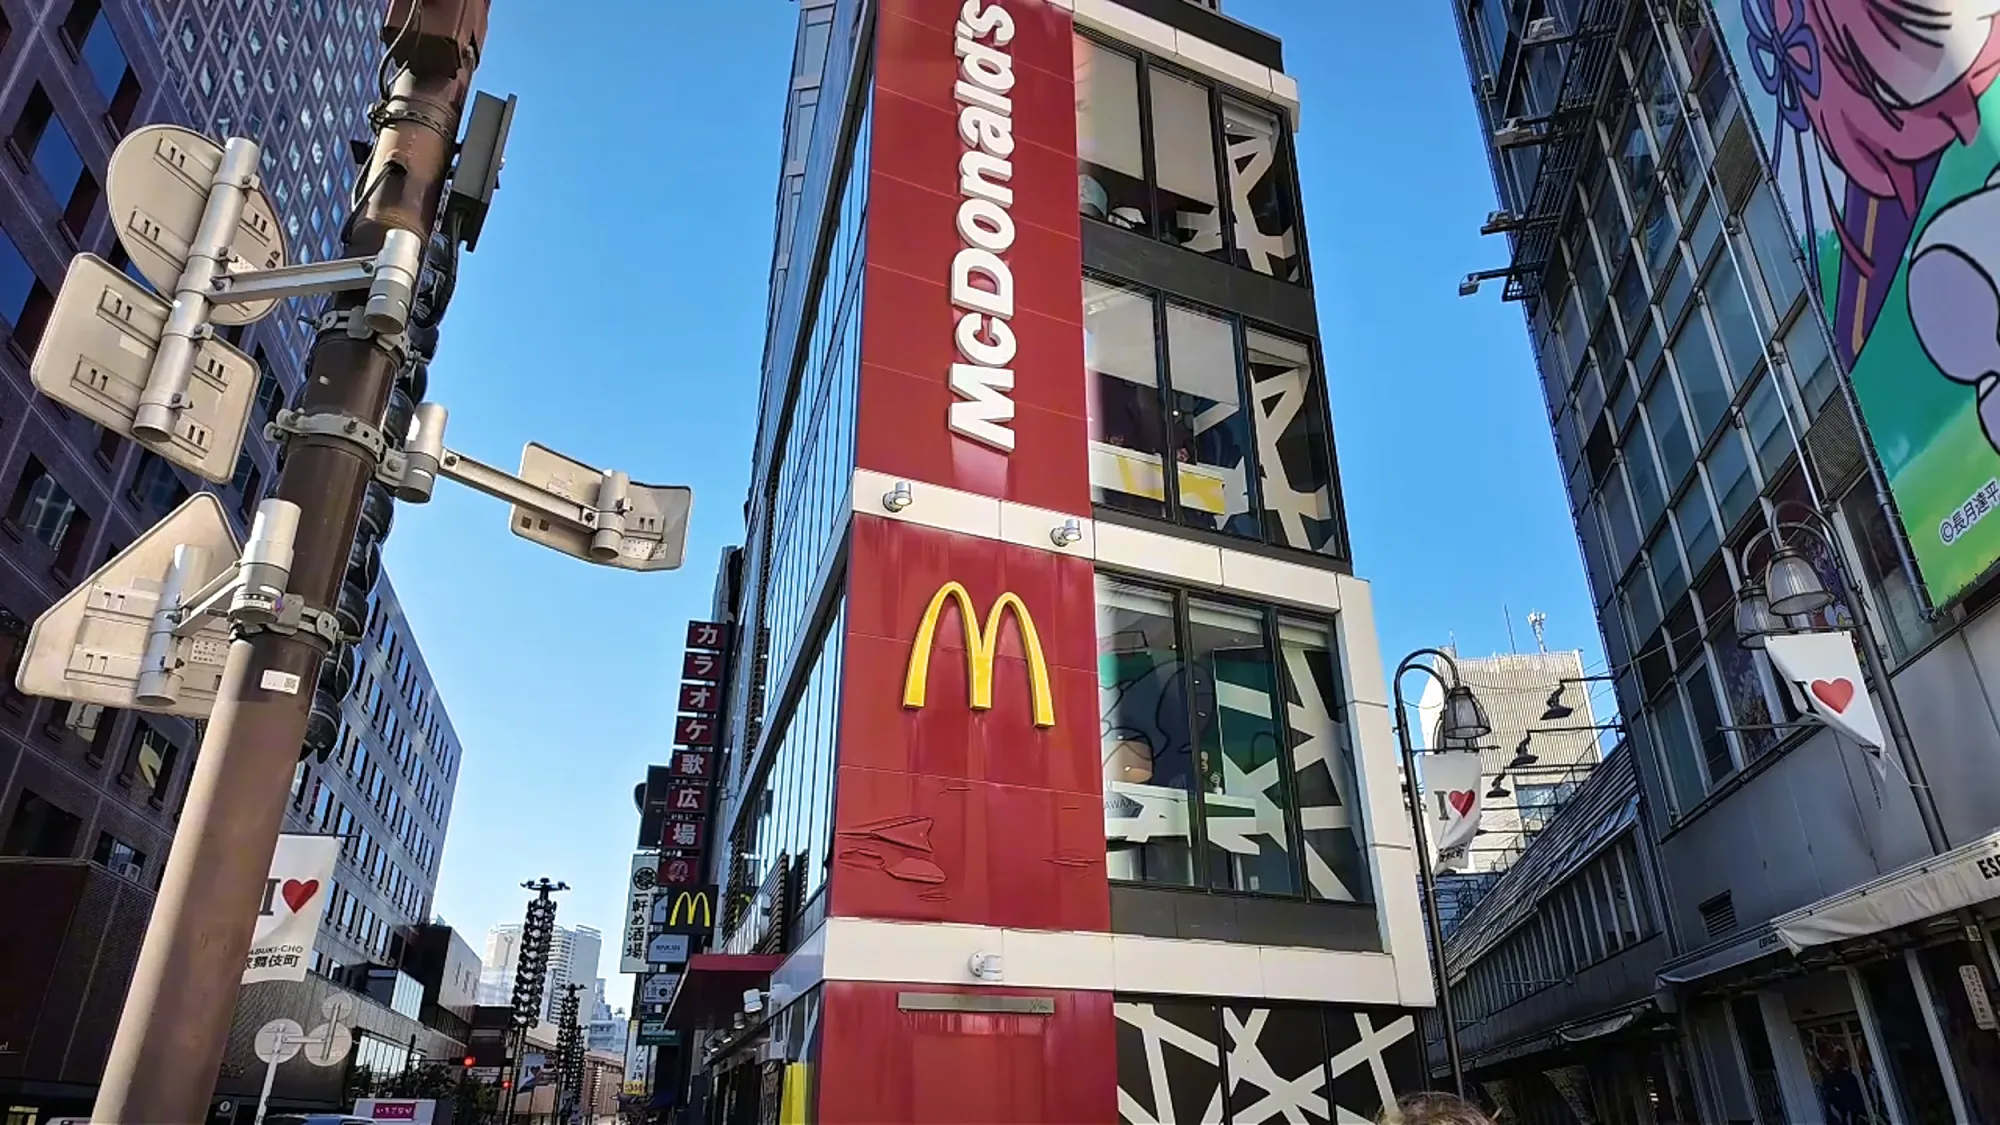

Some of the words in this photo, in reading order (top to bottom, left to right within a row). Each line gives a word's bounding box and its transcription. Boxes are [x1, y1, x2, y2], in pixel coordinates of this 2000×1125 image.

[948, 0, 1017, 452] McDonald's
[260, 878, 281, 916] I
[247, 944, 304, 955] ABUKI-CHO
